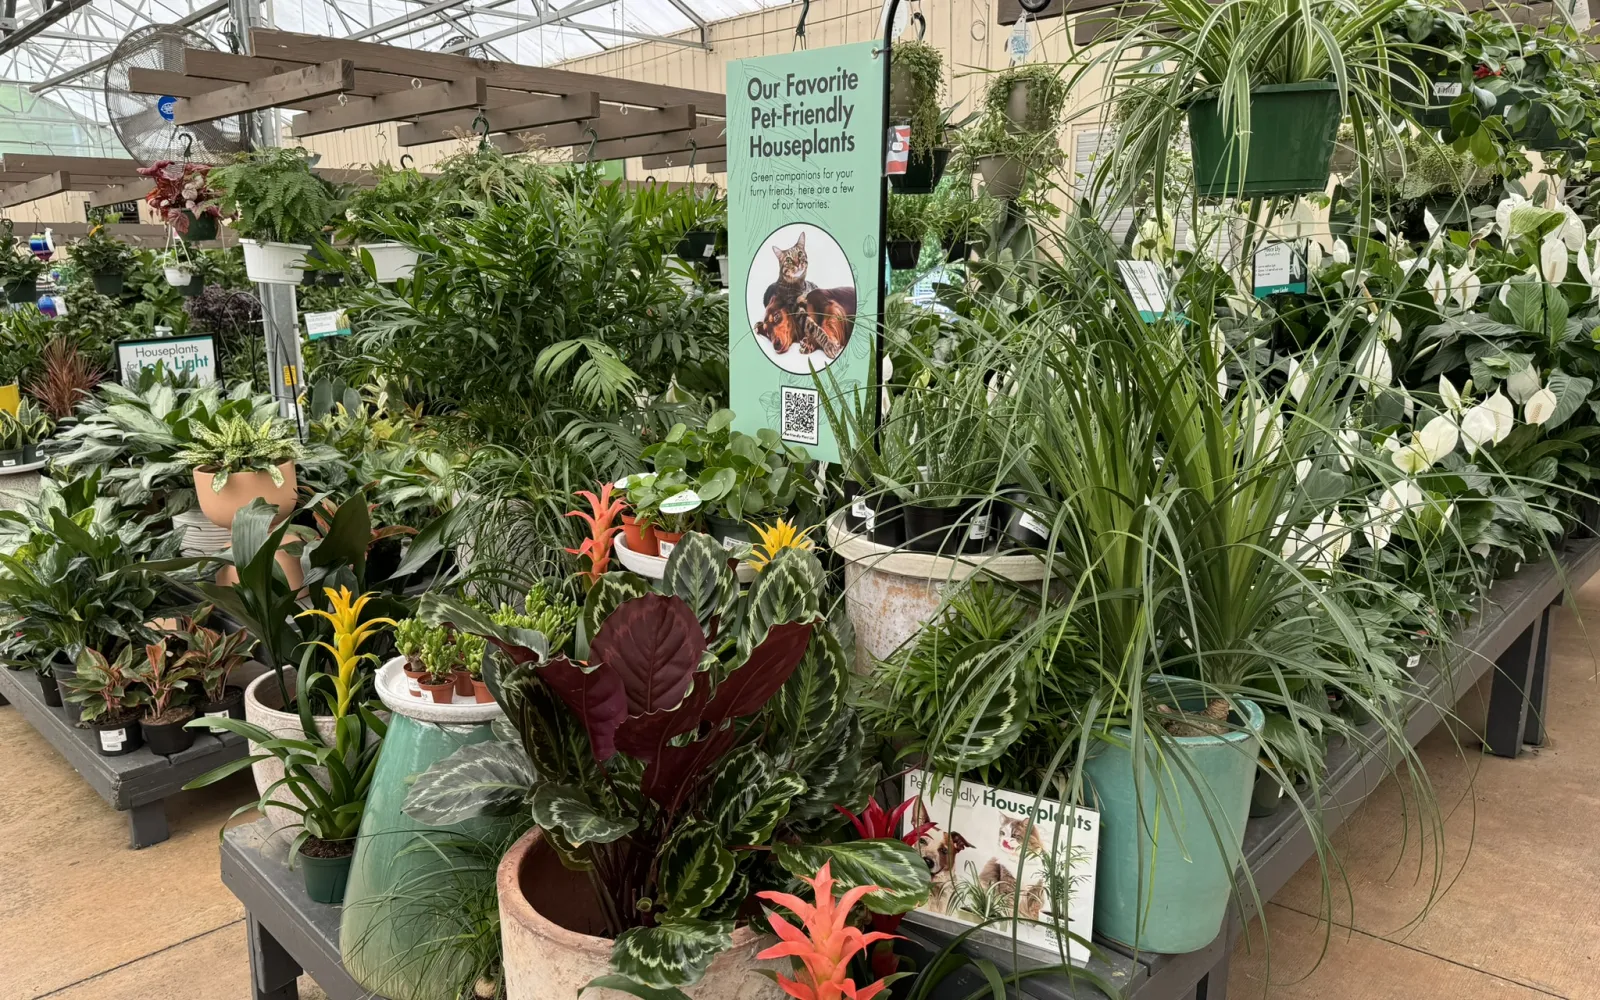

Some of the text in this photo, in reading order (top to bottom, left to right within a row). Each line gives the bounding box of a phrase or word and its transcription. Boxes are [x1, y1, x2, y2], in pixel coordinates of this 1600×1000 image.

[747, 66, 859, 101] Our Favorite
[751, 95, 855, 130] Pet-Friendly
[750, 128, 855, 162] Houseplants
[751, 167, 853, 183] Green companions for your
[750, 181, 855, 198] furry friends, here are a few
[772, 198, 830, 210] of our favorites.
[135, 344, 199, 358] Houseplants
[126, 361, 138, 370] for
[174, 353, 209, 372] Light
[932, 780, 980, 807] riedly
